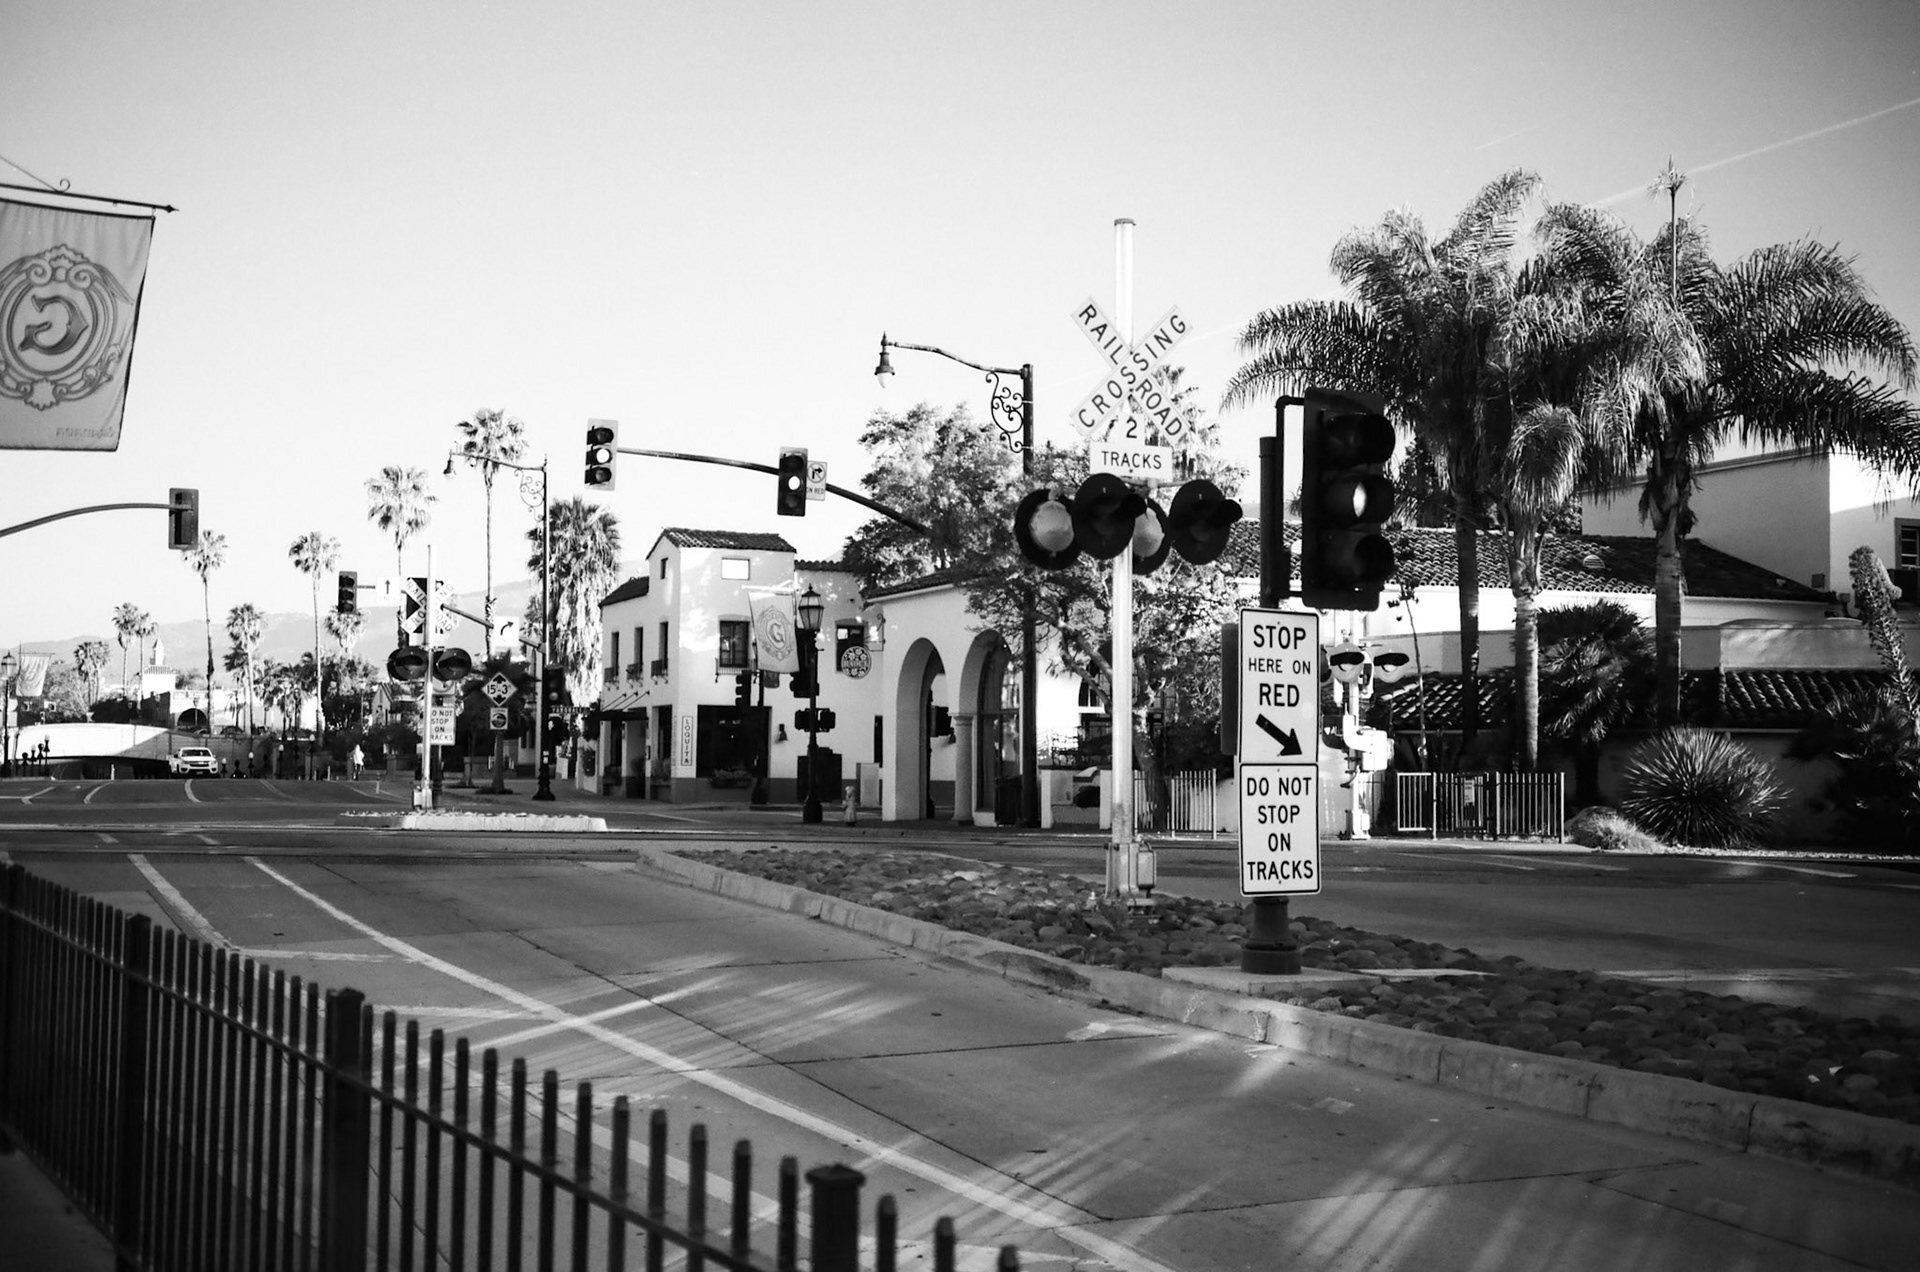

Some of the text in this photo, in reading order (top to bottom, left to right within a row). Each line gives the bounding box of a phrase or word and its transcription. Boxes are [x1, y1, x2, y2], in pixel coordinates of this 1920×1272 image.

[1078, 315, 1186, 428] CROSSING
[1125, 417, 1138, 439] 2
[1101, 450, 1162, 470] TRACKS
[1252, 624, 1307, 650] STOP
[1248, 657, 1311, 675] HERE ON
[1258, 682, 1300, 708] RED
[439, 709, 453, 717] NOT
[683, 718, 691, 764] LOQUITA
[1246, 777, 1312, 796] DO NOT
[1257, 804, 1301, 825] STOP
[1267, 832, 1291, 852] ON
[1247, 860, 1314, 881] TRACKS
